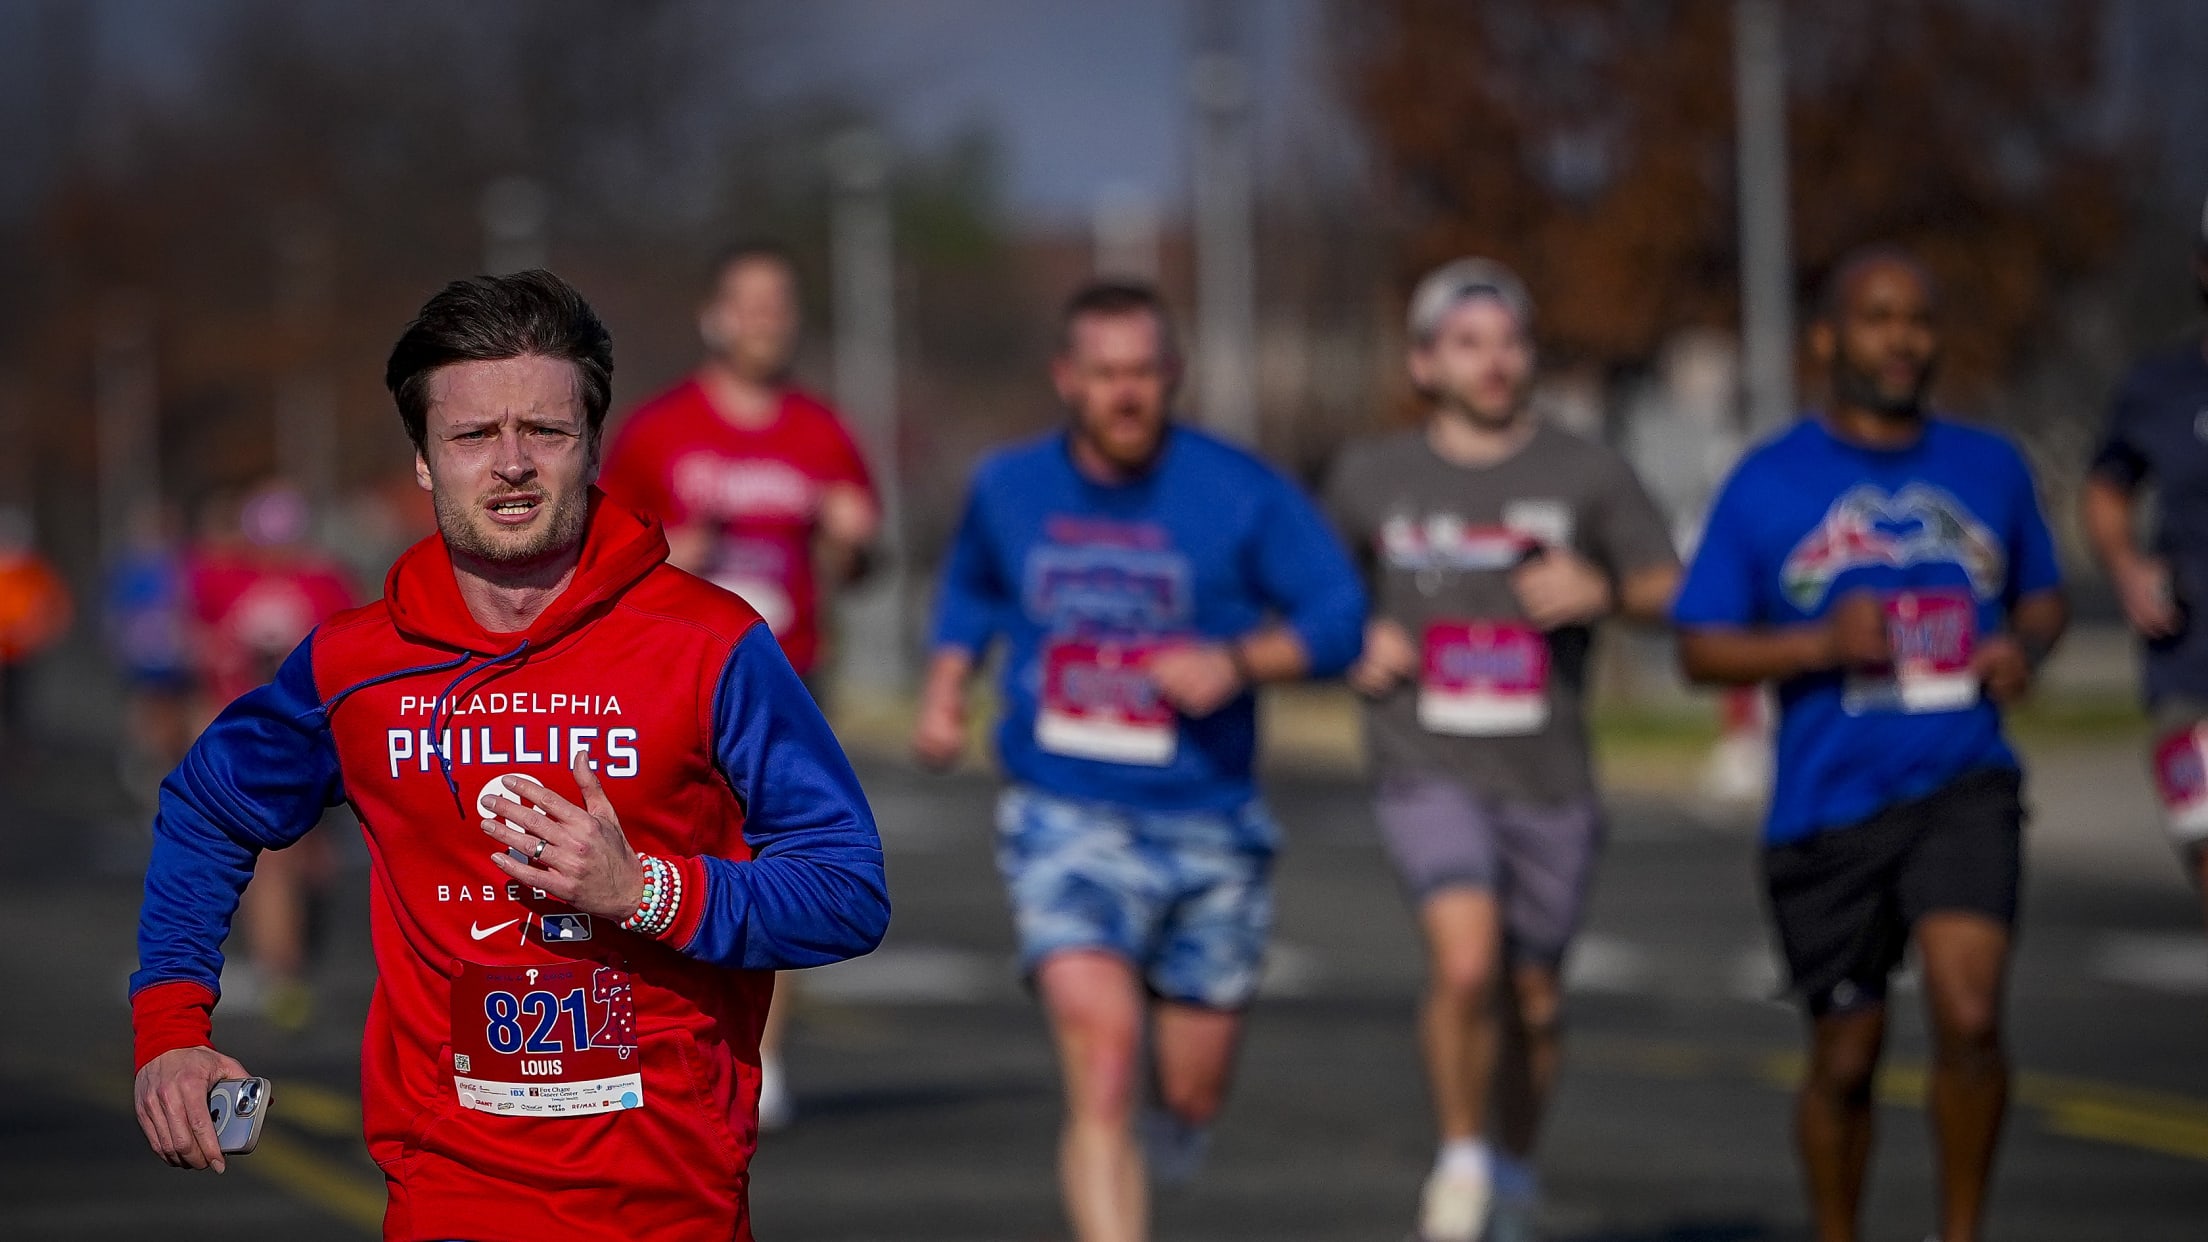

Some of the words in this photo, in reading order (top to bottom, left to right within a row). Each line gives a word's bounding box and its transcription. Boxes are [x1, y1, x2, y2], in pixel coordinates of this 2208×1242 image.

[400, 692, 622, 715] PHILADELPHIA
[387, 726, 640, 778] PHILLIES
[437, 885, 547, 901] BASEB
[484, 988, 590, 1054] 821
[521, 1060, 563, 1075] LOUIS
